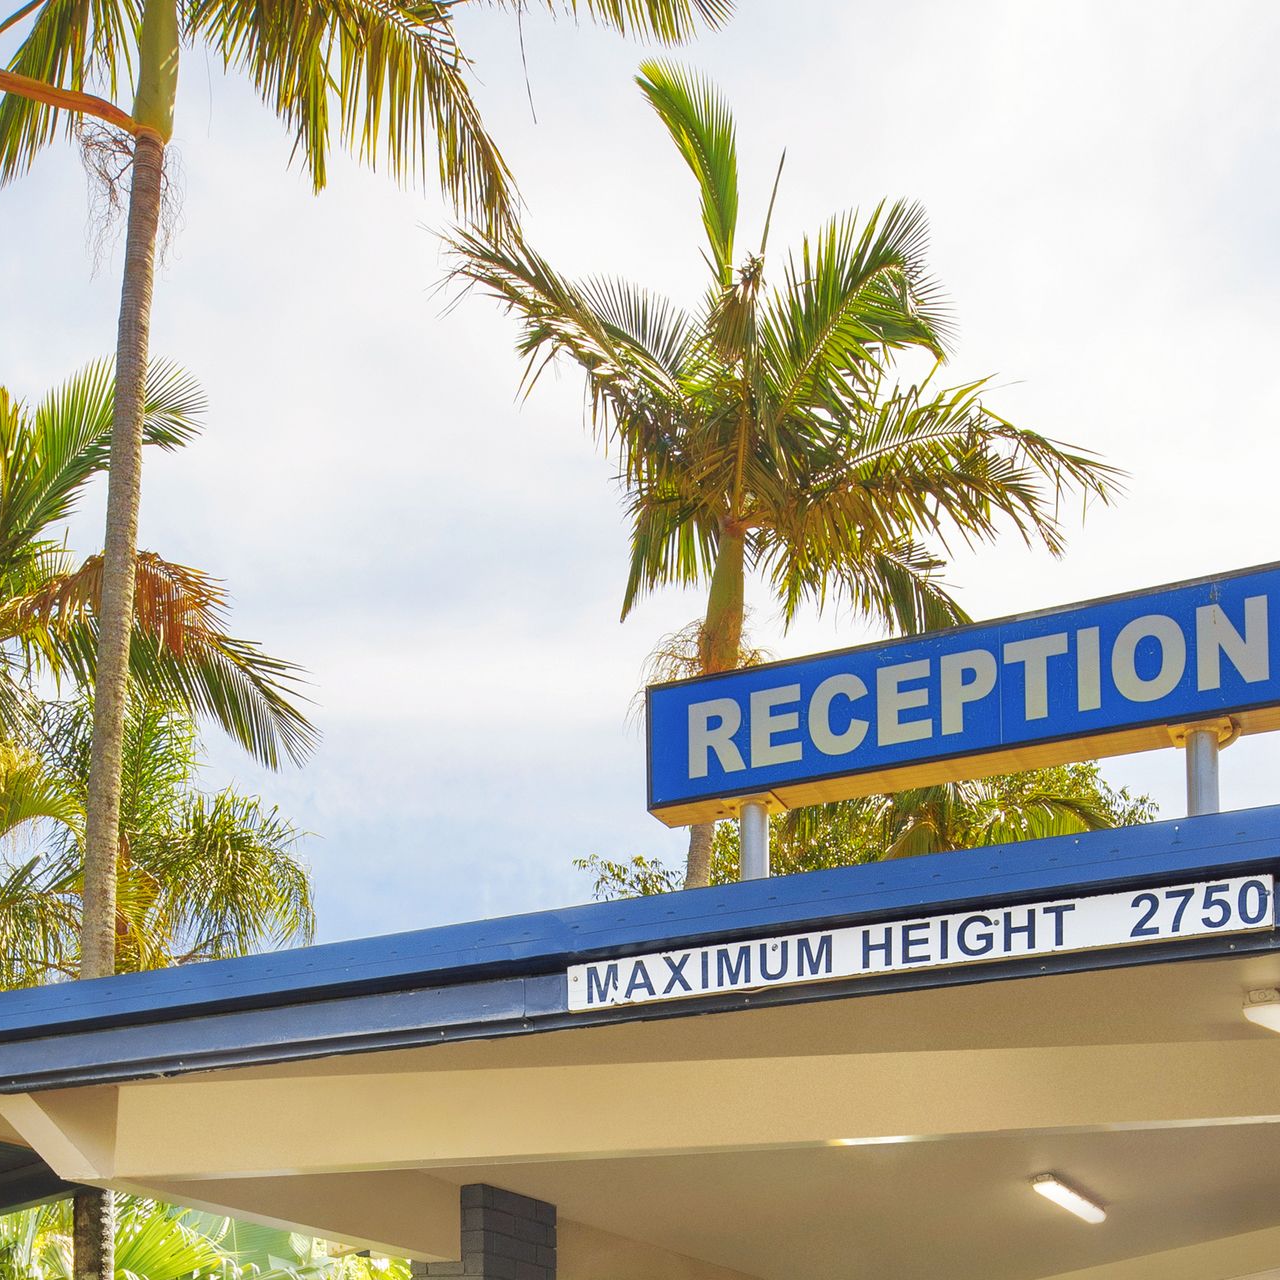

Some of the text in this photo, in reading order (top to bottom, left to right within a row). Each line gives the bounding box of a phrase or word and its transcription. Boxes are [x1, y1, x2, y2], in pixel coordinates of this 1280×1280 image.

[688, 594, 1270, 779] RECEPTION
[587, 879, 1270, 1003] MAXIMUM HEIGHT 2750
